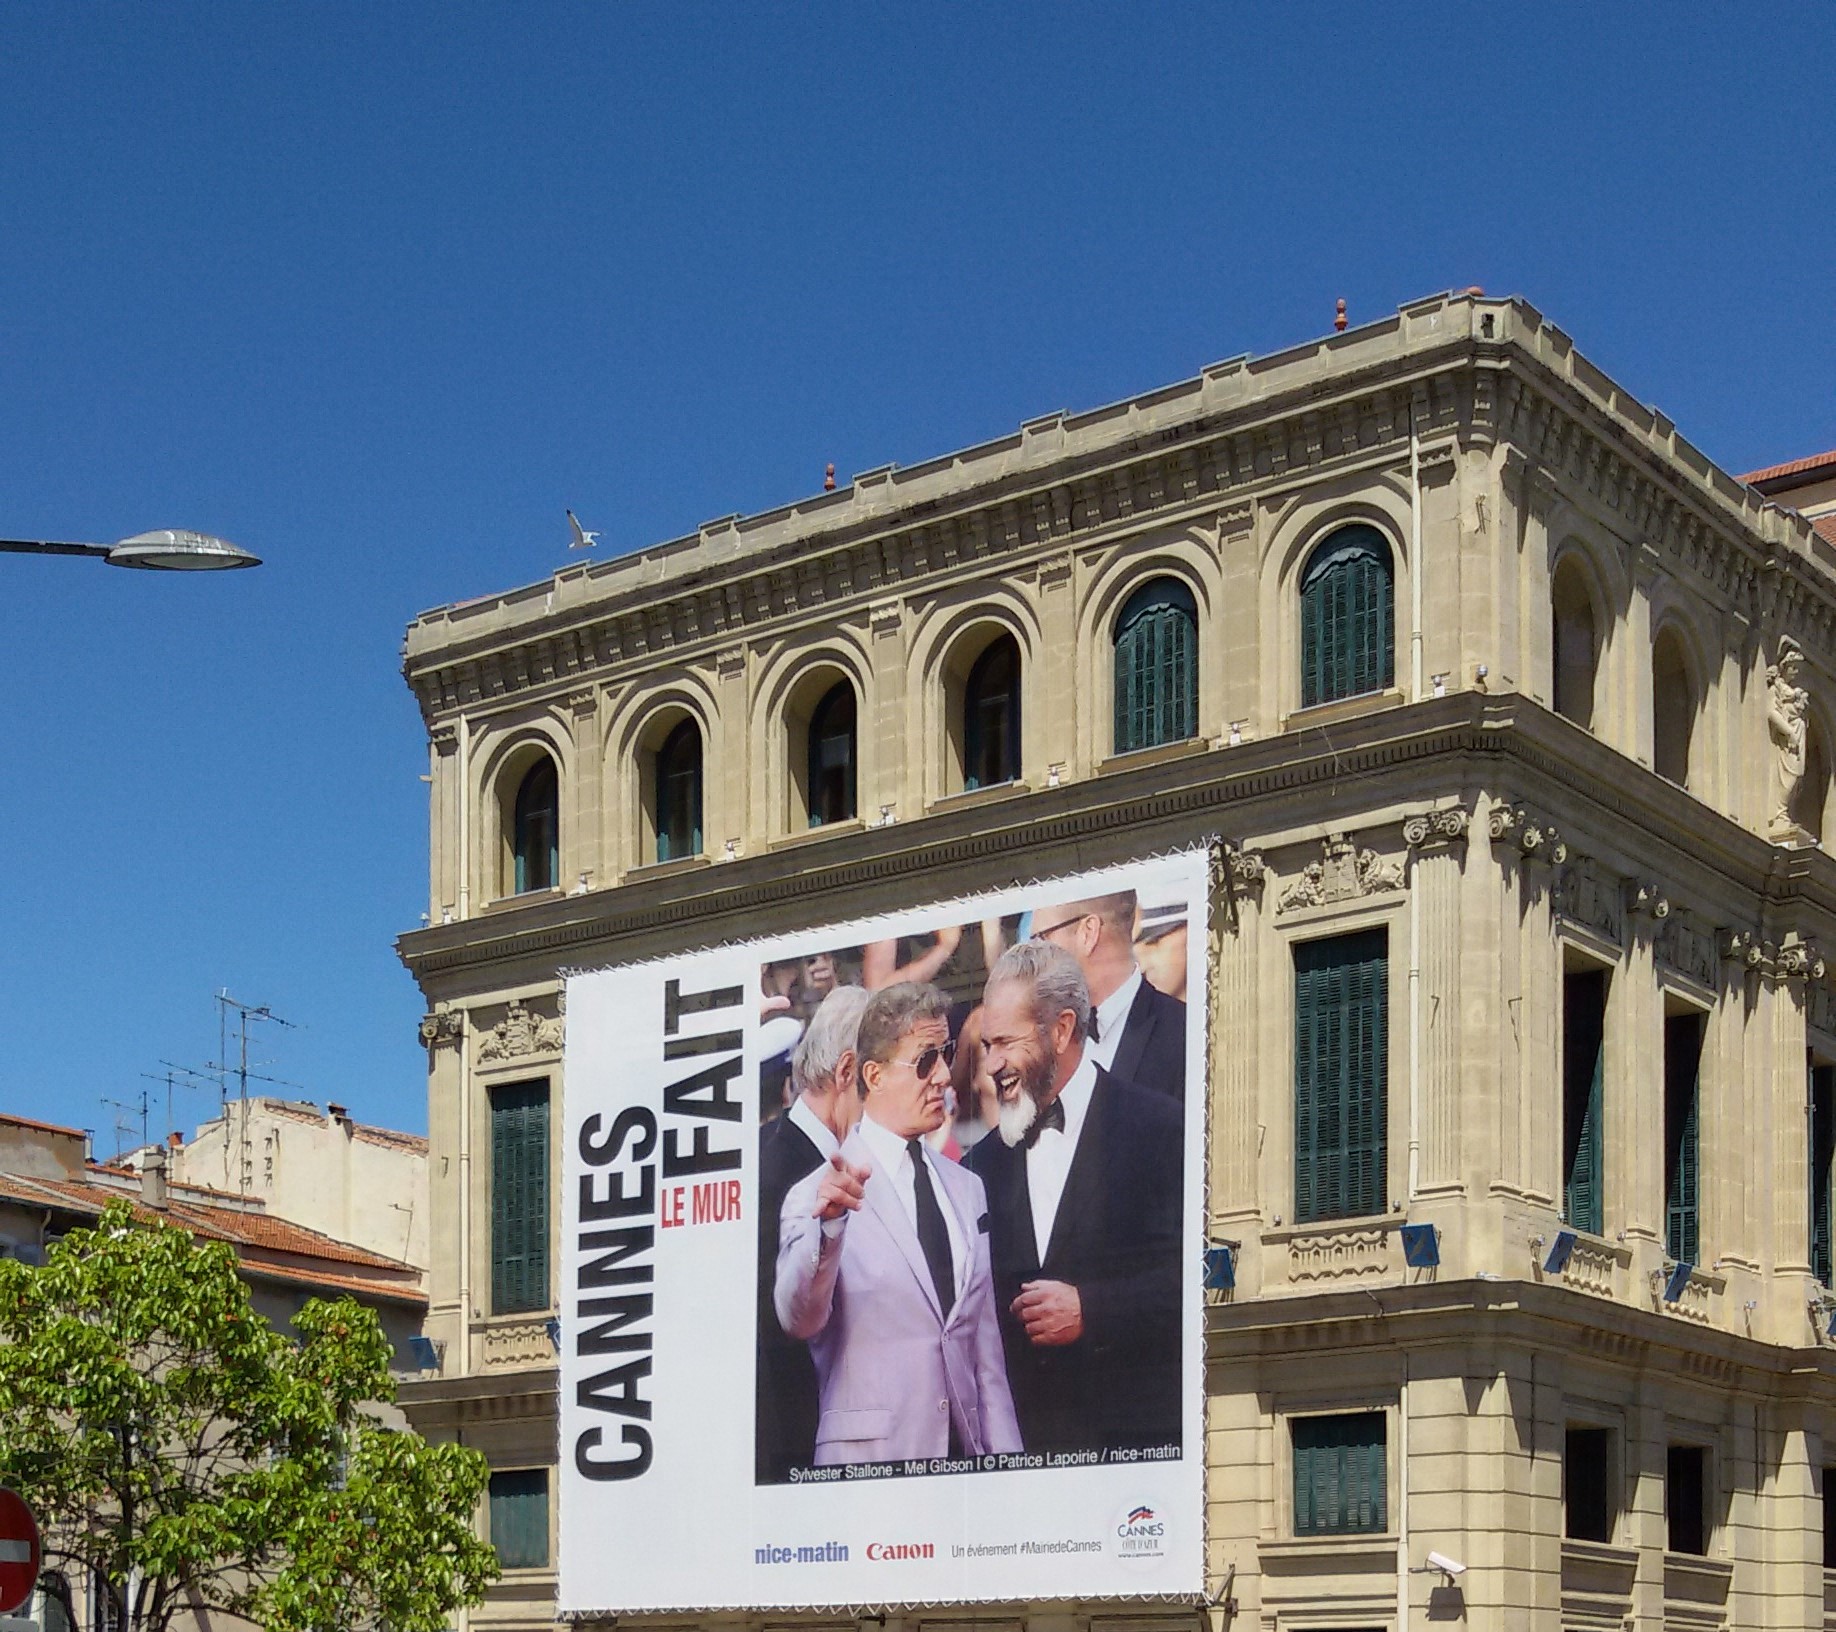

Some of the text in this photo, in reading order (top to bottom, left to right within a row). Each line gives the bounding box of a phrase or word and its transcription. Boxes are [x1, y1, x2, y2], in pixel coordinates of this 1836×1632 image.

[662, 978, 744, 1179] FAIT
[660, 1179, 742, 1229] LE MUR
[575, 1104, 658, 1481] CANNES
[789, 1466, 842, 1485] Sylvester
[845, 1463, 893, 1479] Stallone
[904, 1460, 927, 1475] Mel
[930, 1458, 974, 1474] Gibson
[999, 1453, 1043, 1469] Patrice
[1046, 1449, 1098, 1468] Lapoirie
[1110, 1444, 1181, 1462] nice-matin
[951, 1539, 1102, 1558] Un événement #MairiedeCannes
[1117, 1522, 1165, 1538] CANNES
[866, 1542, 934, 1561] Canon
